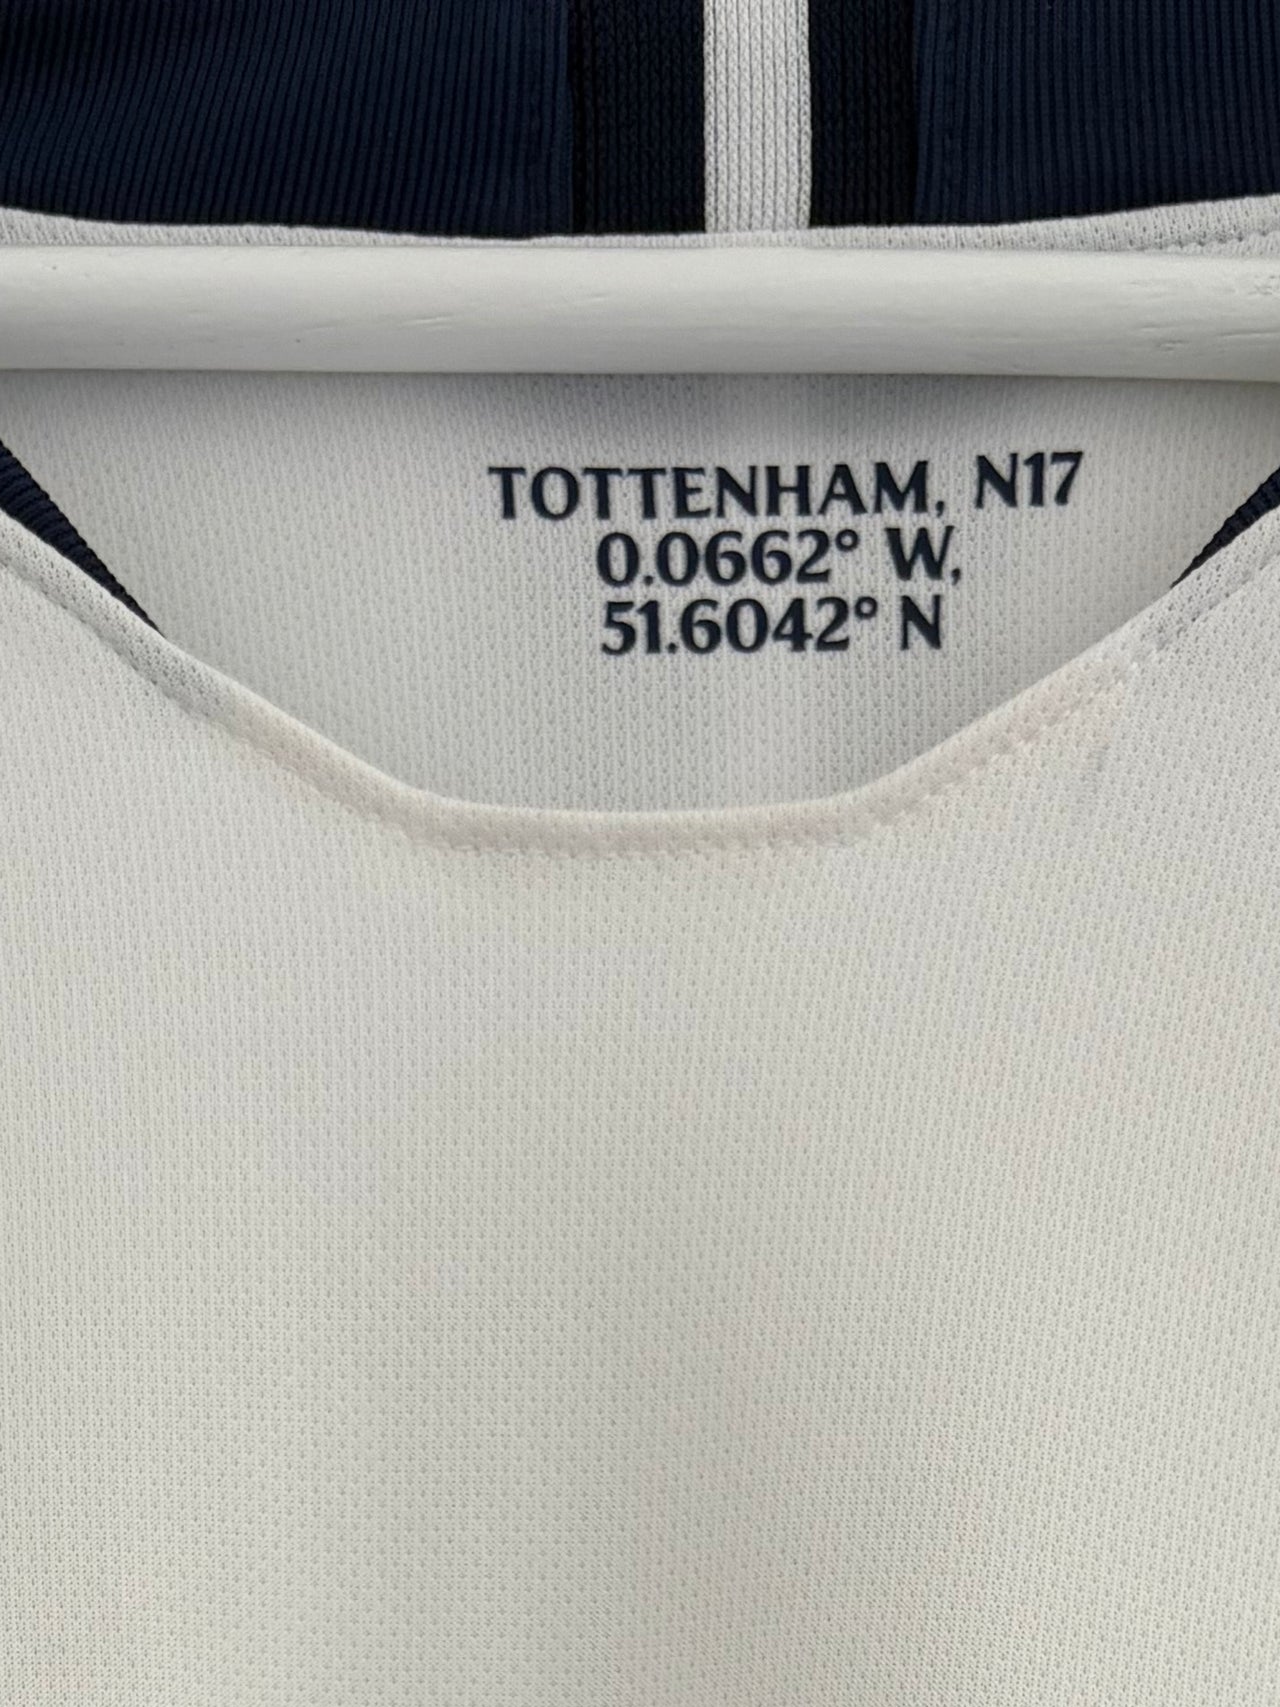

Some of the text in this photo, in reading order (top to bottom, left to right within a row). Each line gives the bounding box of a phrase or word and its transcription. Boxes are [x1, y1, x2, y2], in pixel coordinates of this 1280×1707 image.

[487, 450, 1085, 522] TOTTENHAM, N17
[595, 524, 962, 589] 0.0662° W,
[600, 593, 943, 657] 51.6042° N
